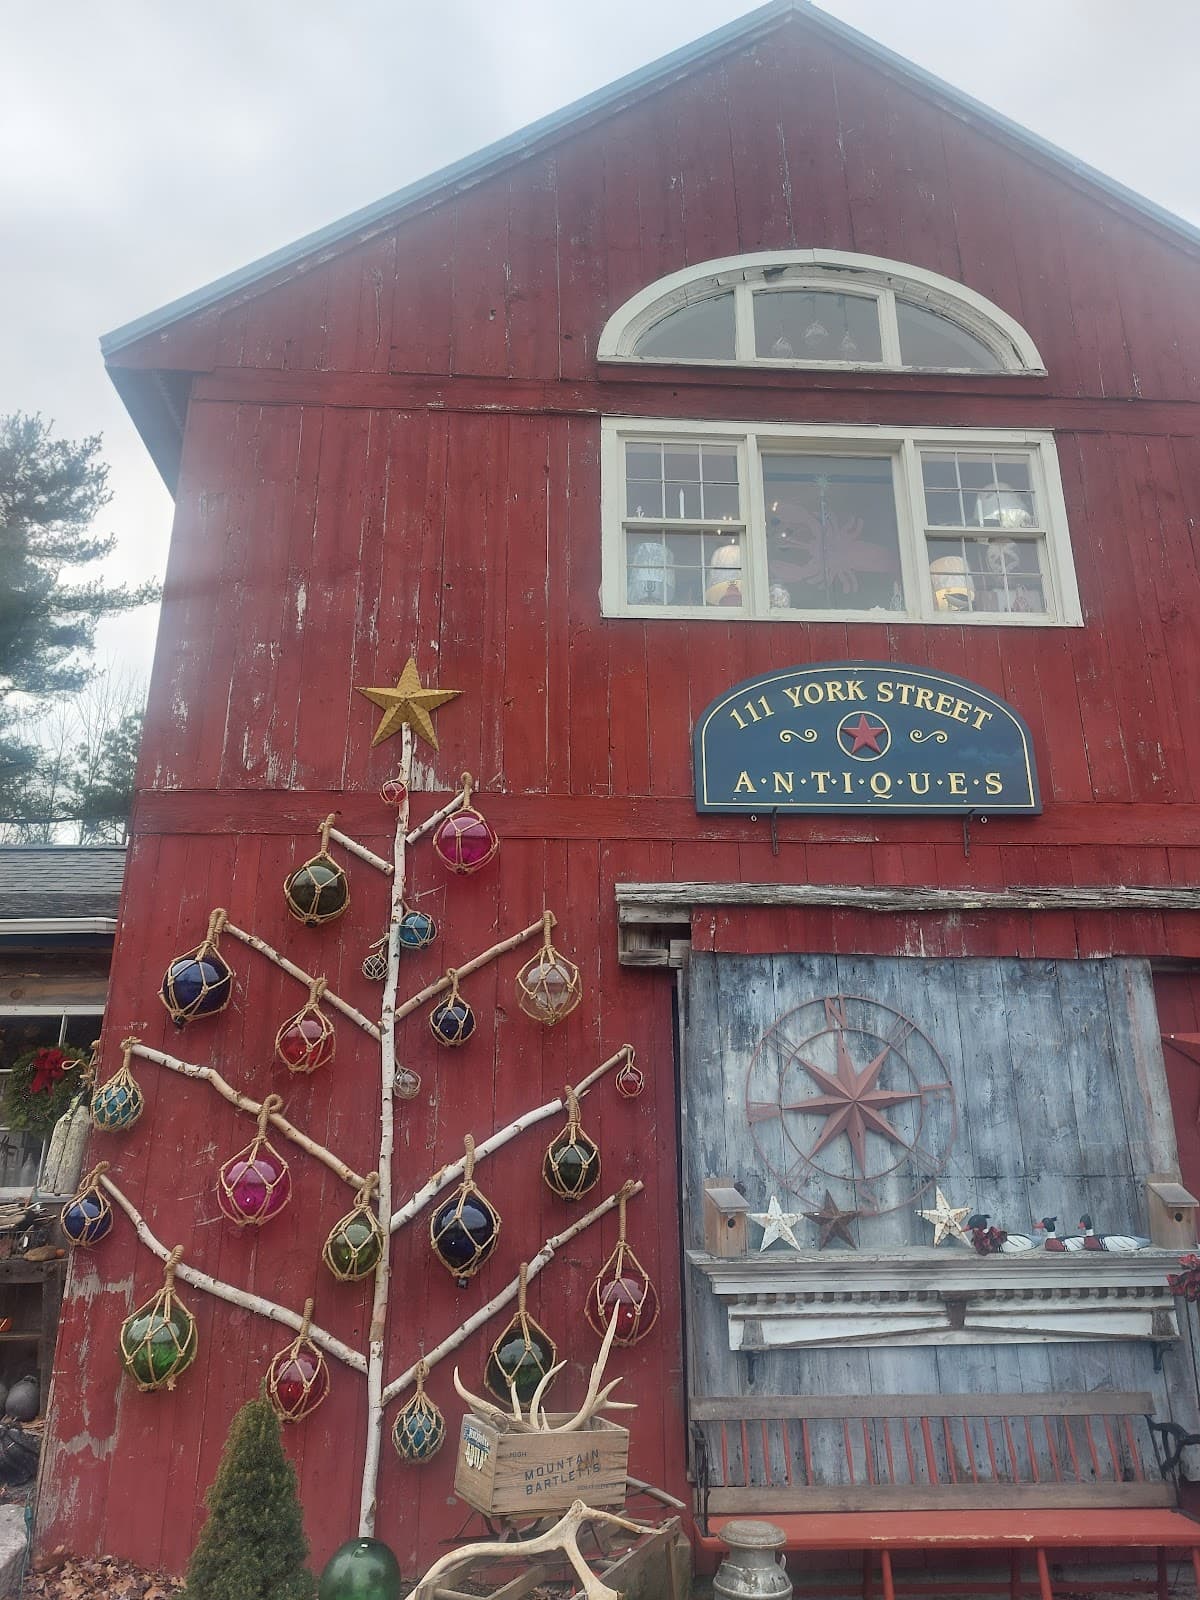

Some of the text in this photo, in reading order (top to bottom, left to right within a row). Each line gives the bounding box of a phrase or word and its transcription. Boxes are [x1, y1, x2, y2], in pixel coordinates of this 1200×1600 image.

[729, 680, 994, 731] 111 YORK STREET
[524, 1449, 600, 1481] MOUNTAIN
